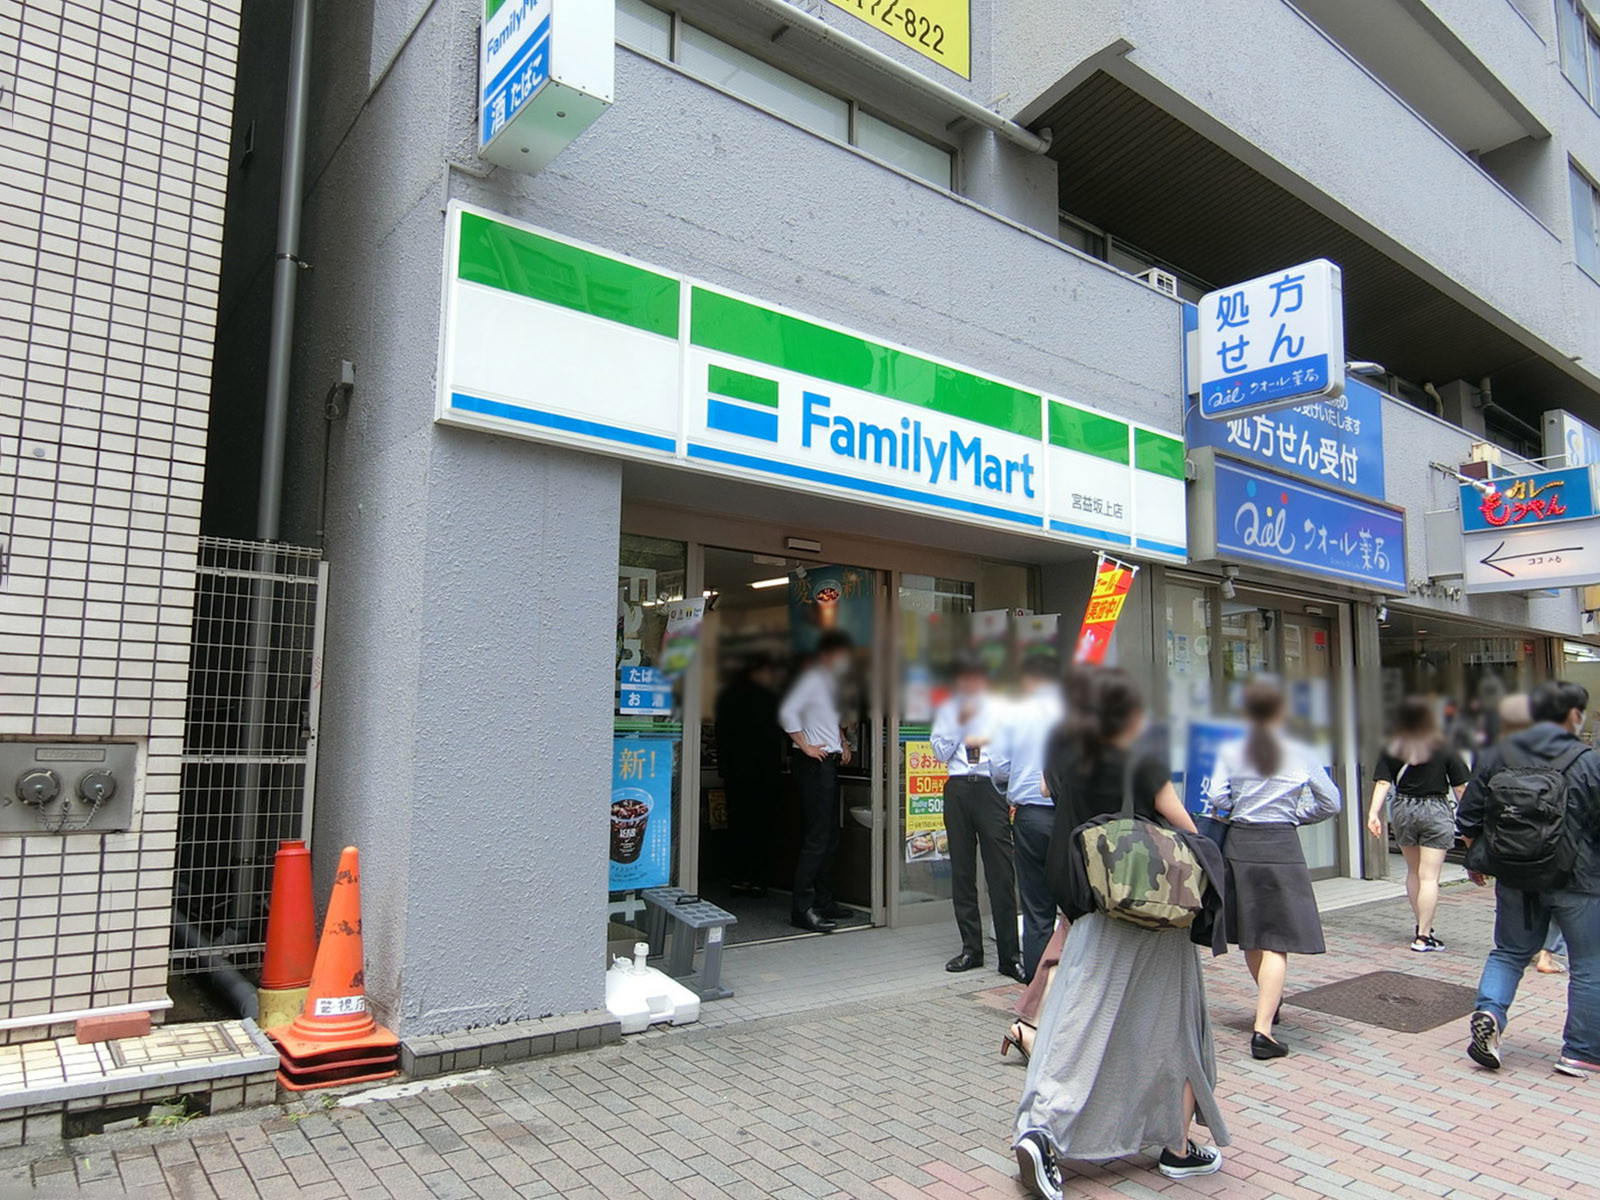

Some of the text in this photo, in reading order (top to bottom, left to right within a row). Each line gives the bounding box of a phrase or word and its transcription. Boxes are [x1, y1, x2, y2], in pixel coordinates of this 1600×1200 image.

[801, 390, 1035, 499] FamilyMart
[1227, 414, 1359, 485] 処方せん受付
[1505, 479, 1565, 499] カレー
[1071, 493, 1123, 519] 宮益坂上店
[618, 748, 656, 780] 新!
